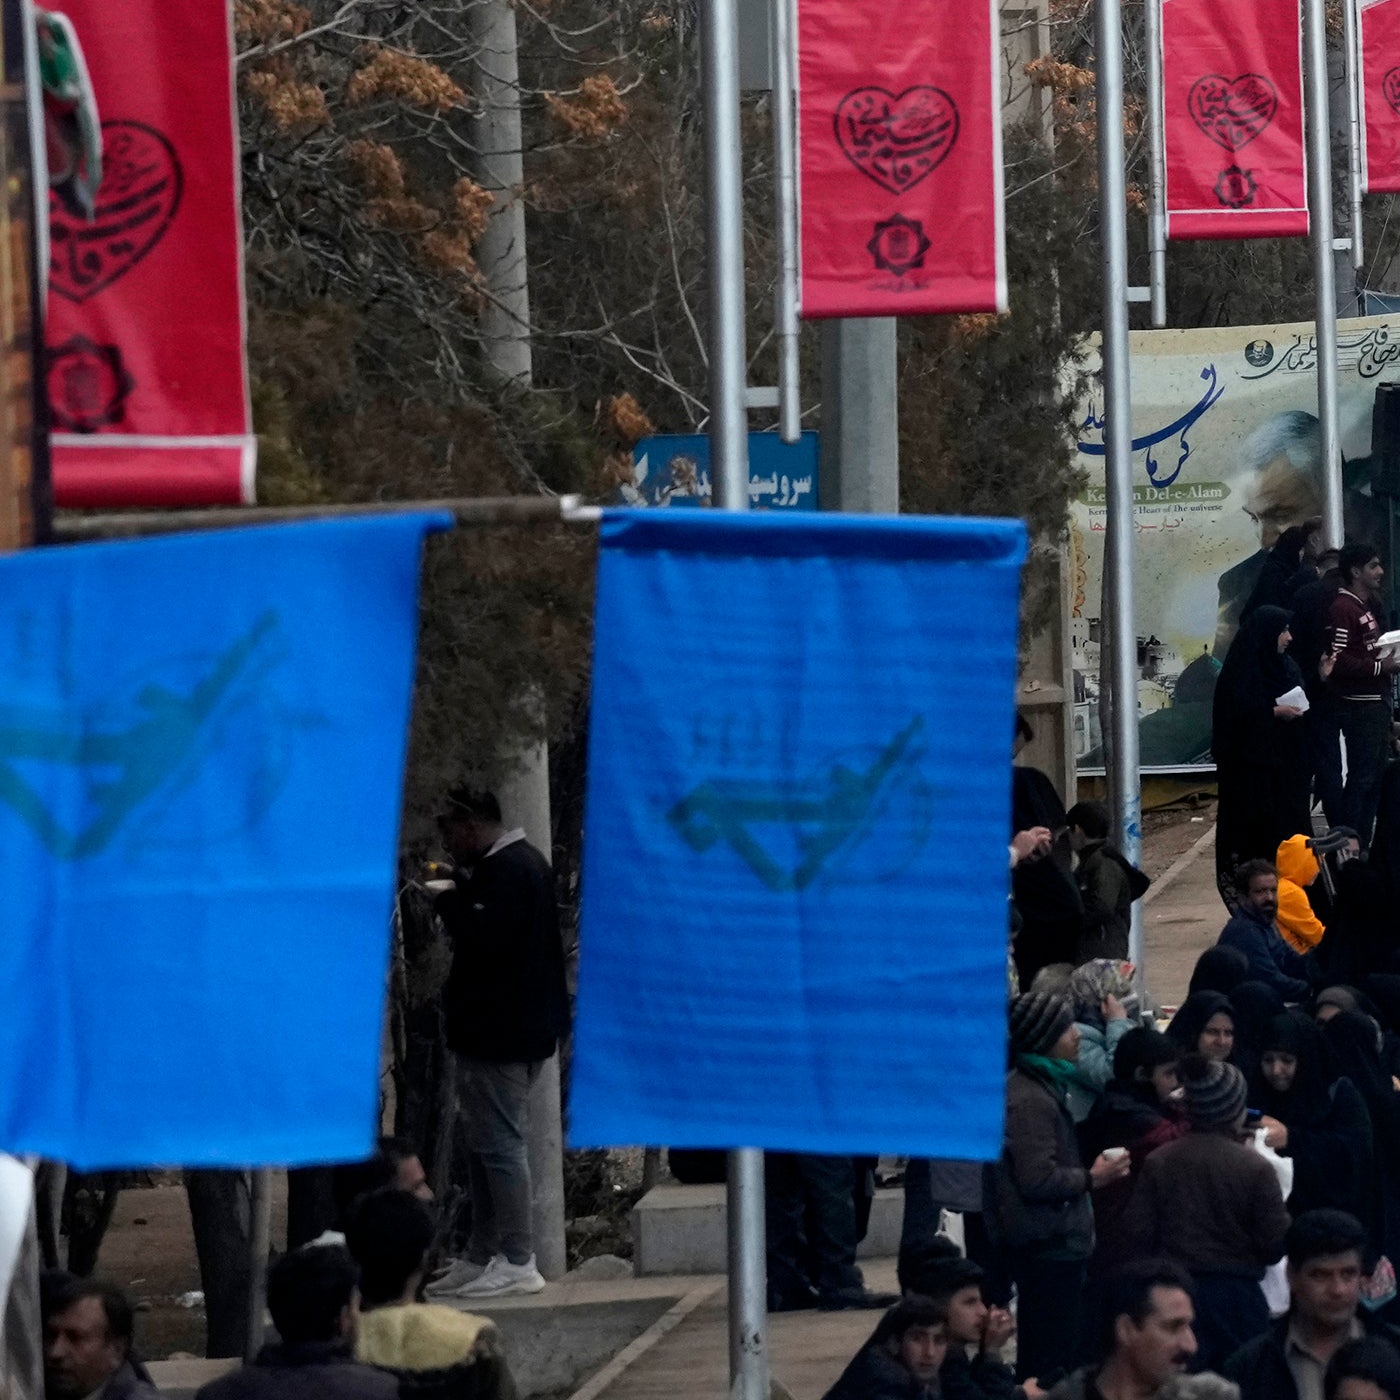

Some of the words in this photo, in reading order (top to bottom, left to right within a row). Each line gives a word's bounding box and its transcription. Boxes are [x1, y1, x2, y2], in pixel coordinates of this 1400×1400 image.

[1240, 334, 1318, 380] لیمانی
[1087, 488, 1141, 502] Ken
[1146, 485, 1223, 501] Del-e-Alam
[1139, 506, 1161, 514] Heart
[1190, 503, 1224, 512] universe
